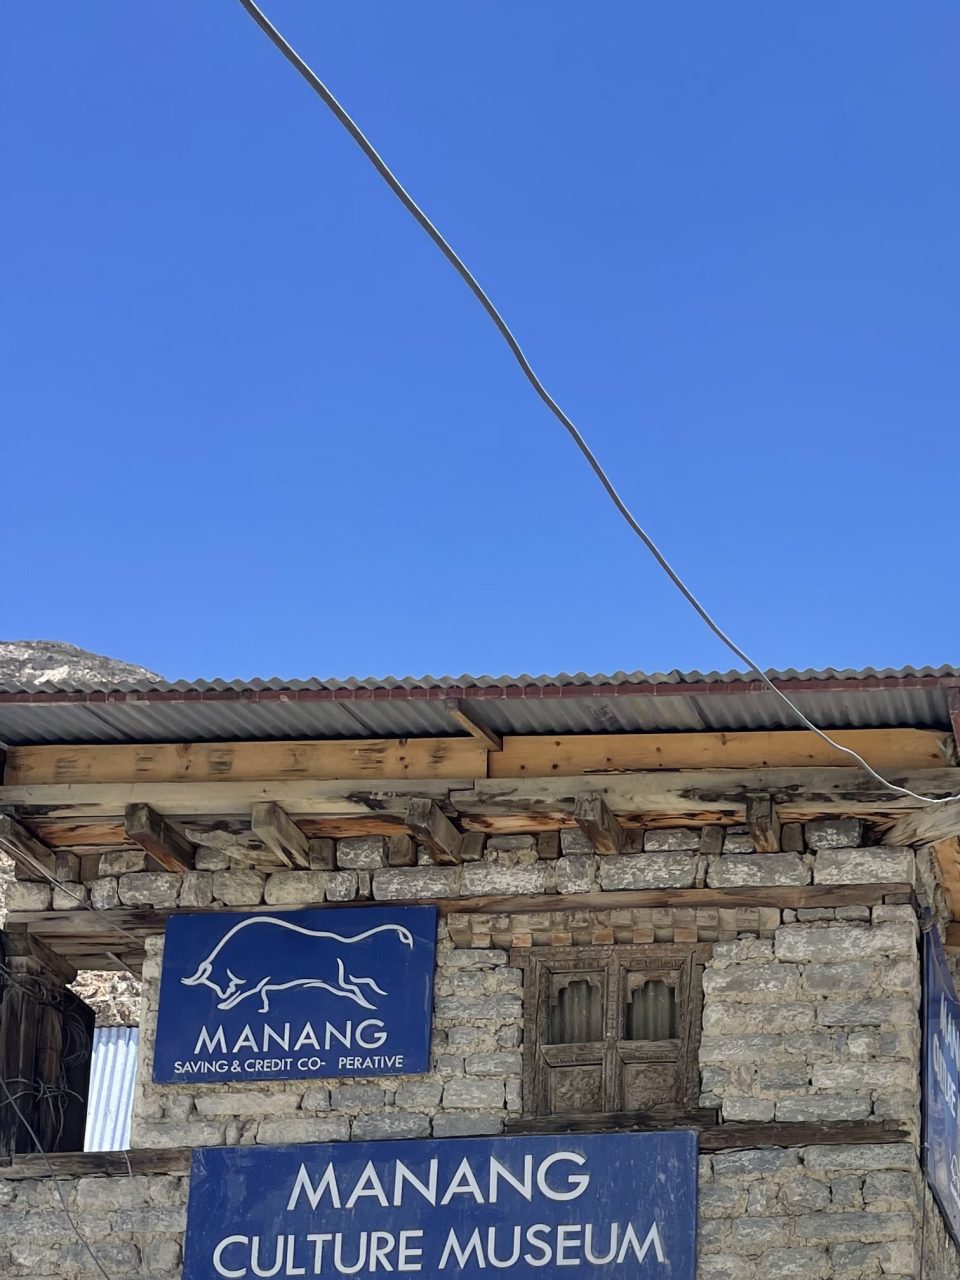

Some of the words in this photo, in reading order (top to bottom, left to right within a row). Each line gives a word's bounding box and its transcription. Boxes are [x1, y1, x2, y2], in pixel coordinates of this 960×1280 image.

[193, 1018, 388, 1055] MANANG
[174, 1059, 229, 1073] SAVING
[230, 1058, 242, 1072] &
[244, 1057, 292, 1073] CREDIT
[338, 1055, 404, 1070] PERATIVE
[286, 1151, 591, 1211] MANANG
[212, 1229, 424, 1279] CULTURE
[438, 1221, 665, 1270] MUSEUM
